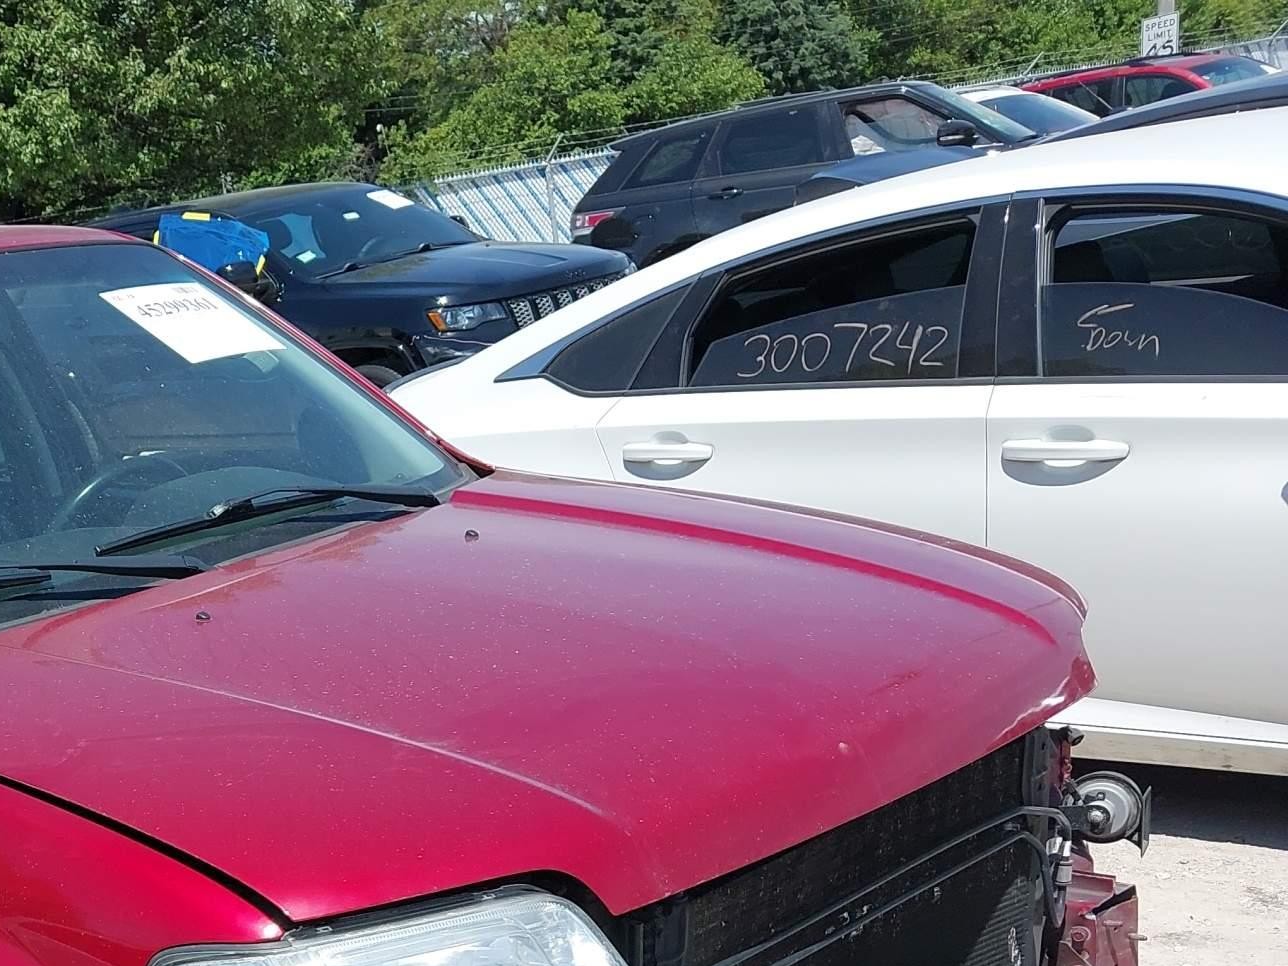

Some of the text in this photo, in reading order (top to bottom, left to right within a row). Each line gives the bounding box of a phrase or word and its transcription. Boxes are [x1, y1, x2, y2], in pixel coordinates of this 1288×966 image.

[1144, 18, 1176, 32] SPEED
[1147, 29, 1173, 42] LIMIT
[1145, 39, 1175, 56] 45
[136, 297, 219, 318] 45299361
[737, 320, 949, 378] 3007242
